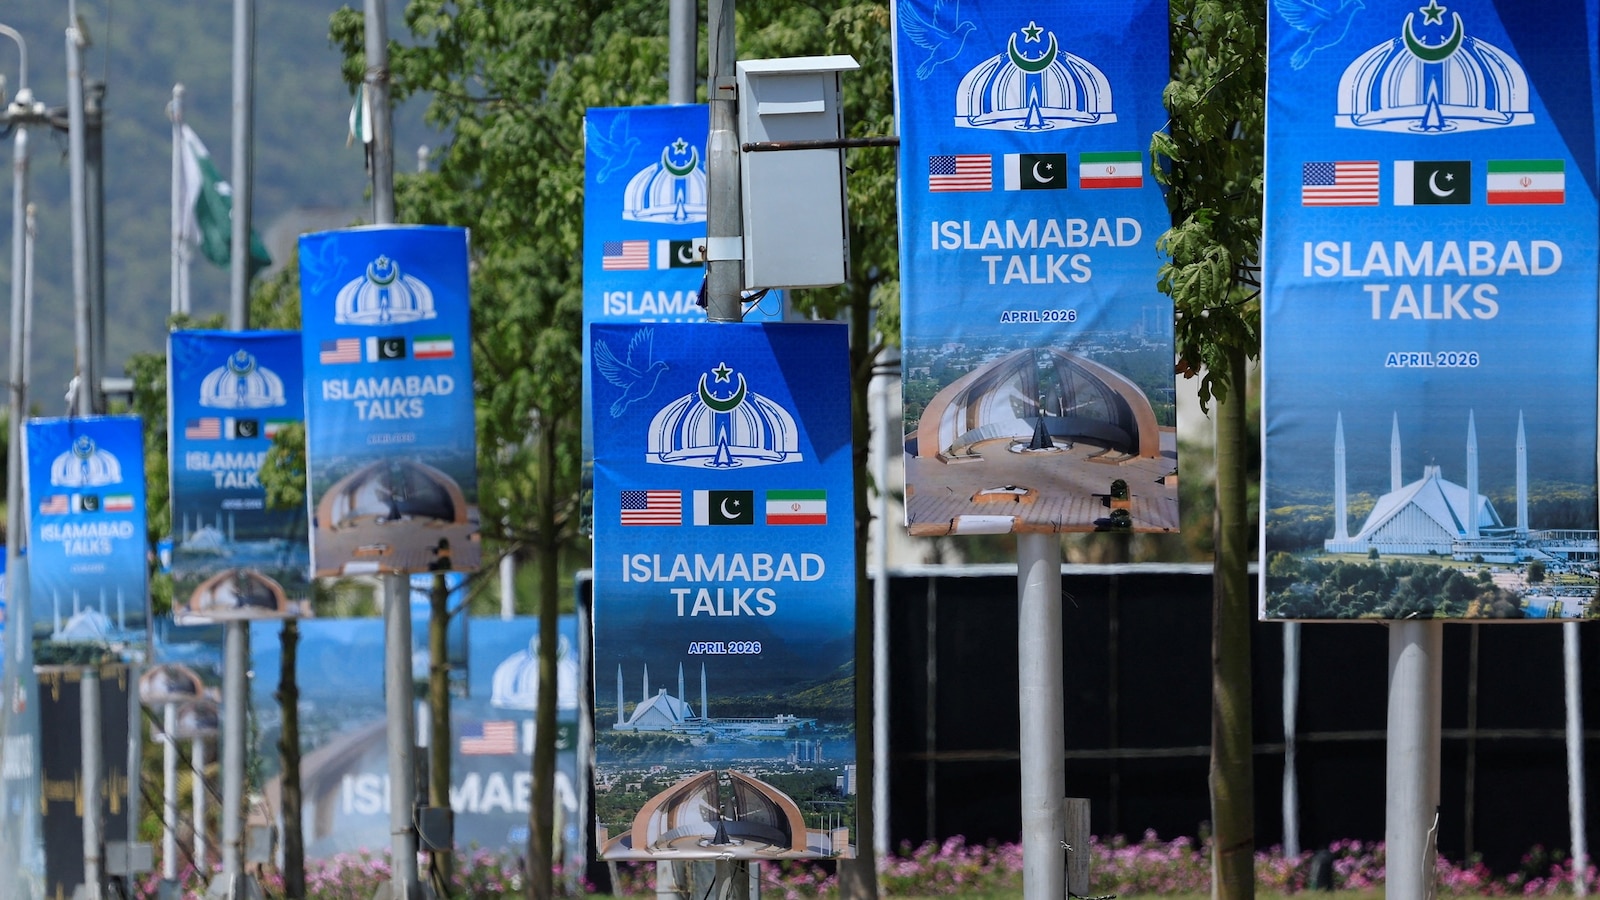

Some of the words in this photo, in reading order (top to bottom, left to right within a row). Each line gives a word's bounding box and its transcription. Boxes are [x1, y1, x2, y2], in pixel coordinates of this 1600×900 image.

[931, 217, 1142, 250] ISLAMABAD
[981, 254, 1092, 285] TALKS
[1303, 240, 1563, 277] ISLAMABAD
[1363, 283, 1500, 320] TALKS
[1000, 311, 1040, 323] APRIL
[1042, 310, 1077, 322] 2026
[1385, 353, 1435, 368] APRIL
[1437, 352, 1480, 367] 2026
[322, 374, 455, 401] ISLAMABAD
[354, 397, 424, 421] TALKS
[212, 470, 265, 490] TALK
[41, 520, 135, 542] ISLAMABAD
[63, 537, 113, 557] TALKS
[622, 553, 826, 583] ISLAMABAD
[670, 588, 777, 617] TALKS
[688, 642, 726, 654] APRIL
[729, 641, 762, 654] 2026
